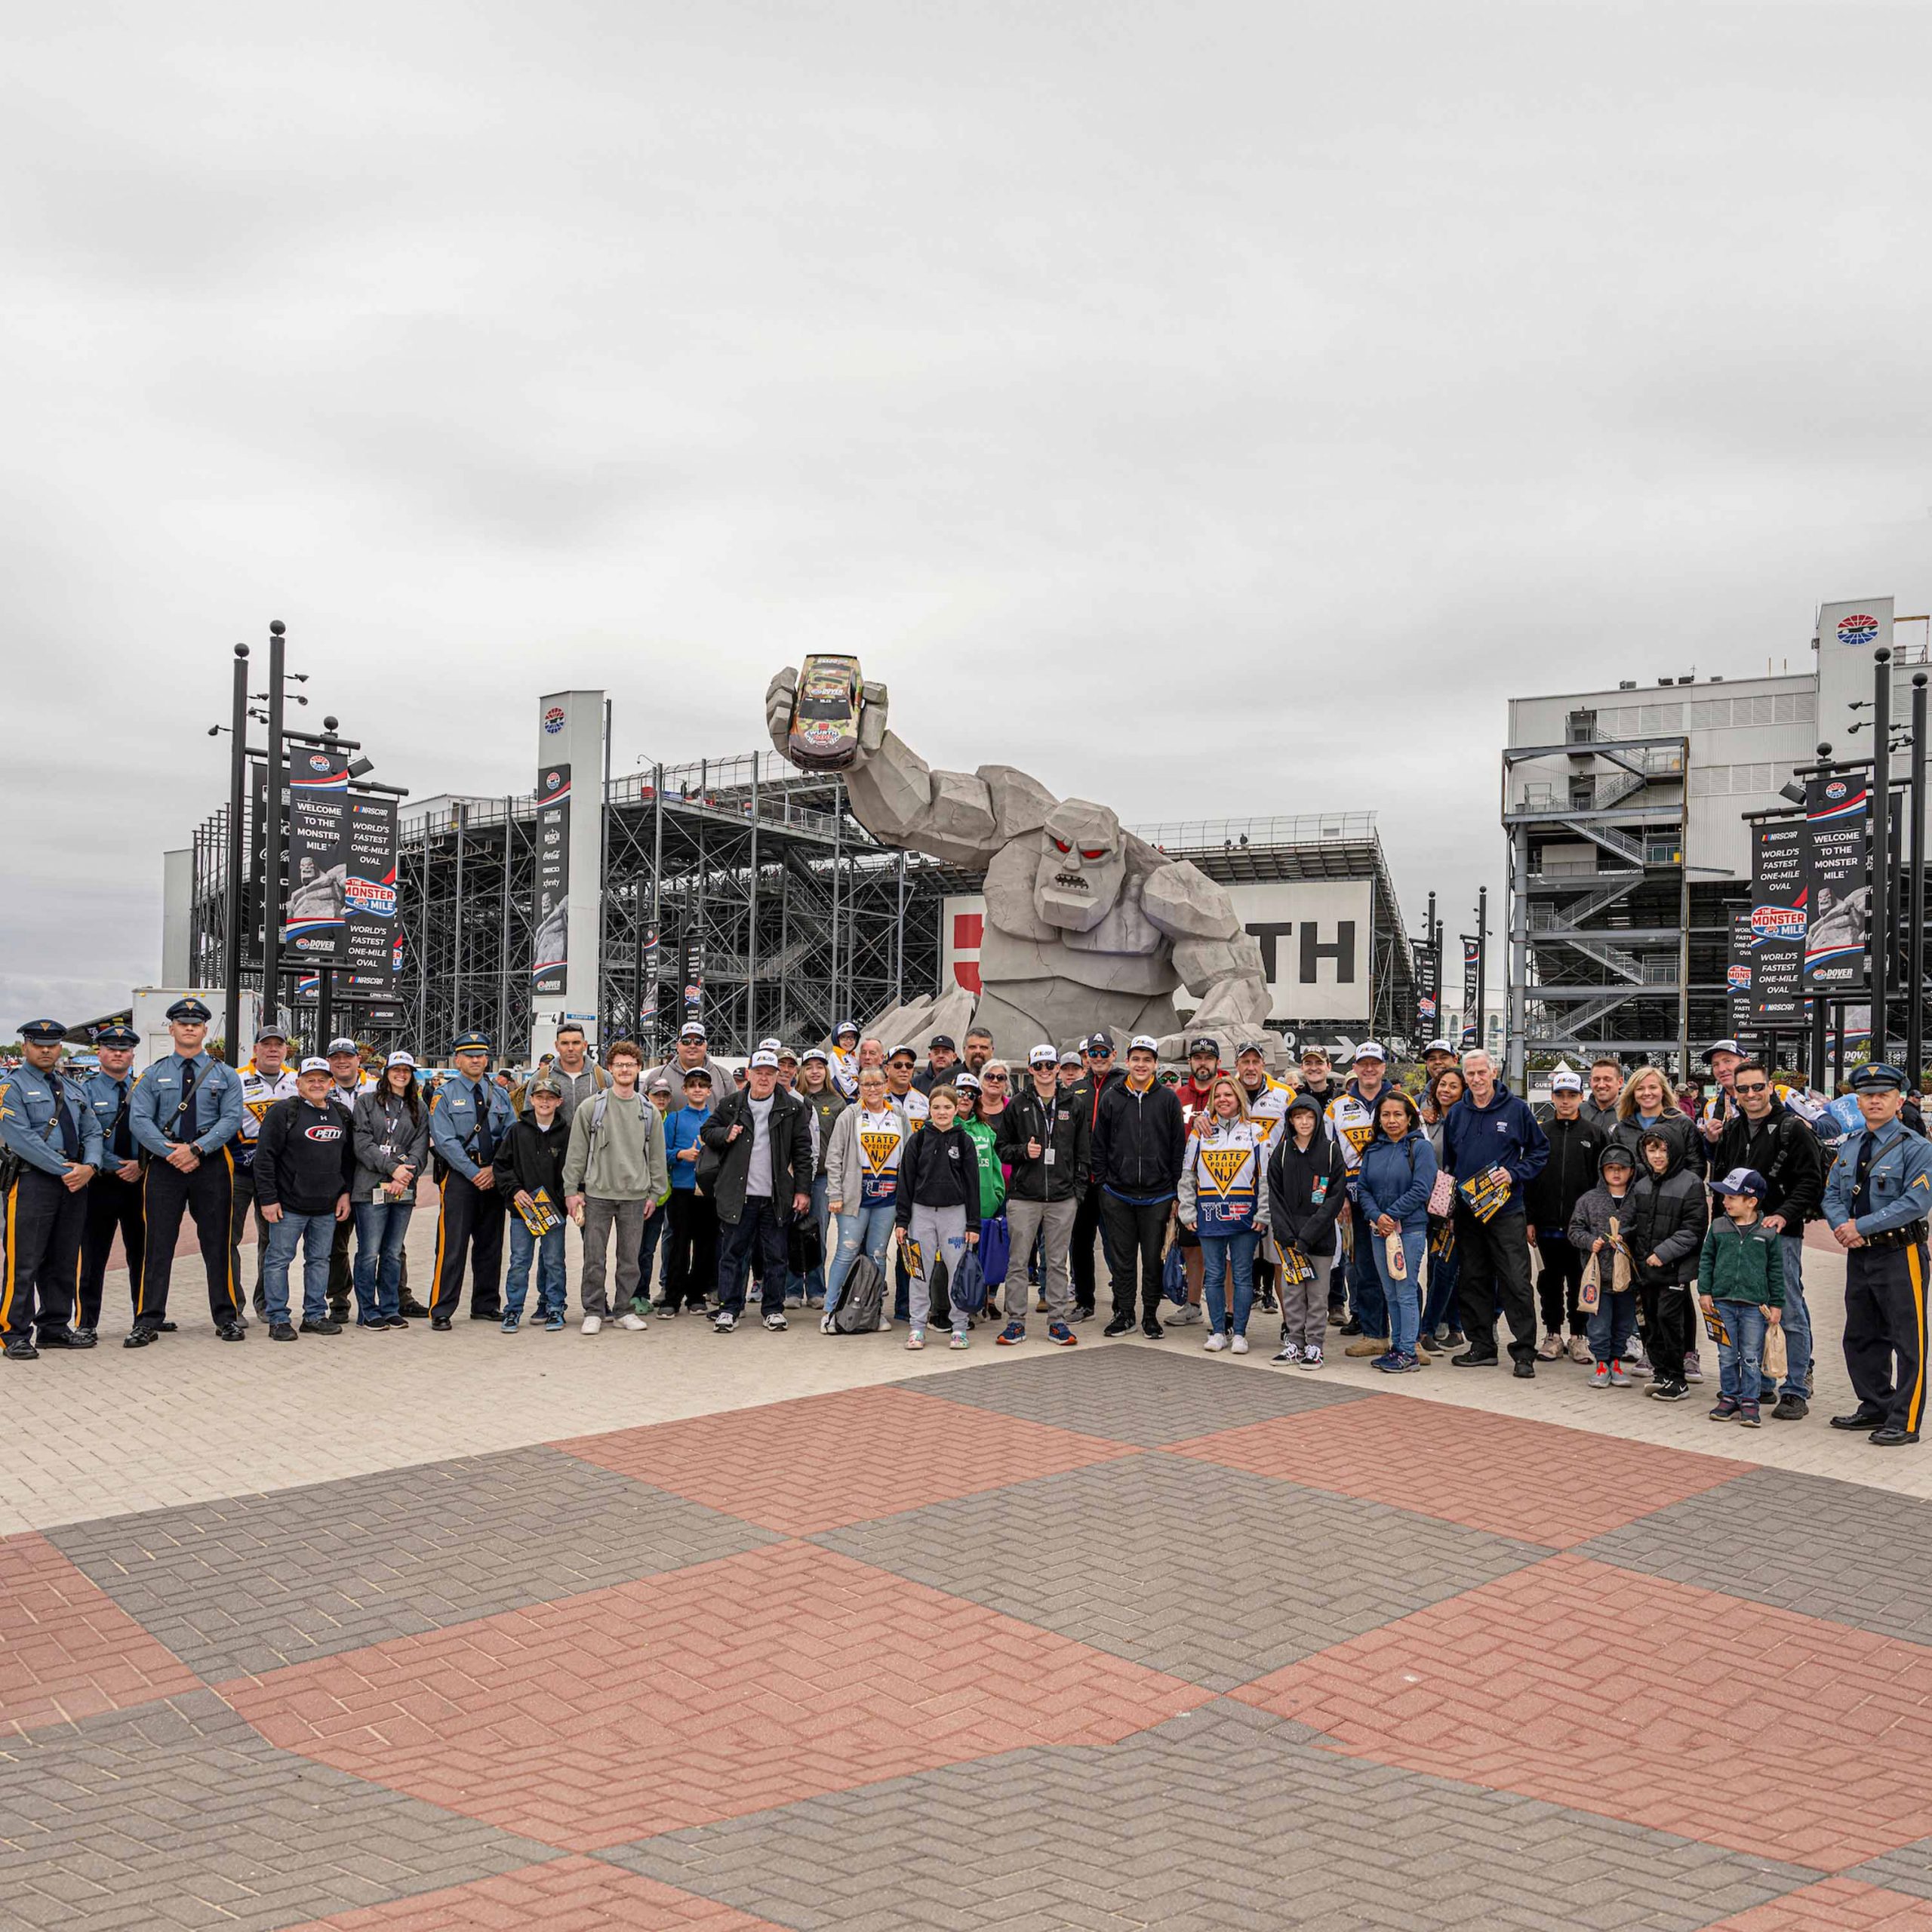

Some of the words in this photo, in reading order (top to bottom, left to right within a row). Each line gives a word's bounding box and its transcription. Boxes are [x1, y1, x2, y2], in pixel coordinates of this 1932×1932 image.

[297, 802, 342, 816] WELCOME
[361, 807, 388, 817] NASCAR
[304, 817, 315, 825] TO
[317, 818, 335, 828] THE
[352, 822, 389, 833] WORLD'S
[297, 828, 340, 841] MONSTER
[354, 833, 388, 844] FASTEST
[1770, 831, 1798, 841] NASCAR
[1814, 832, 1860, 844] WELCOME
[306, 841, 328, 851] MILE
[351, 844, 390, 855] ONE-MILE
[1821, 847, 1832, 856] TO
[1835, 846, 1852, 854] THE
[1761, 848, 1799, 858] WORLD'S
[359, 856, 381, 865] OVAL
[1763, 860, 1798, 869] FASTEST
[1815, 857, 1857, 869] MONSTER
[1760, 870, 1800, 881] ONE-MILE
[1823, 871, 1844, 880] MILE
[1769, 882, 1791, 891] OVAL
[345, 886, 394, 900] MONSTER
[371, 900, 393, 910] MILE
[1752, 913, 1804, 926] MONSTER
[349, 925, 386, 935] WORLD'S
[1781, 924, 1804, 934] MILE
[310, 940, 335, 949] DOVER
[351, 936, 385, 946] FASTEST
[348, 947, 386, 957] ONE-MILE
[1761, 952, 1798, 961] WORLD'S
[356, 958, 378, 967] OVAL
[1761, 963, 1796, 972] FASTEST
[1826, 968, 1854, 977] DOVER
[358, 977, 383, 985] NASCAR
[1758, 974, 1798, 983] ONE-MILE
[552, 1014, 557, 1024] 4
[589, 1045, 599, 1063] 3
[315, 1128, 342, 1139] PETTY
[1352, 1131, 1372, 1140] STA
[864, 1136, 894, 1144] STATE
[871, 1151, 886, 1162] NJ
[1214, 1170, 1232, 1182] NJ
